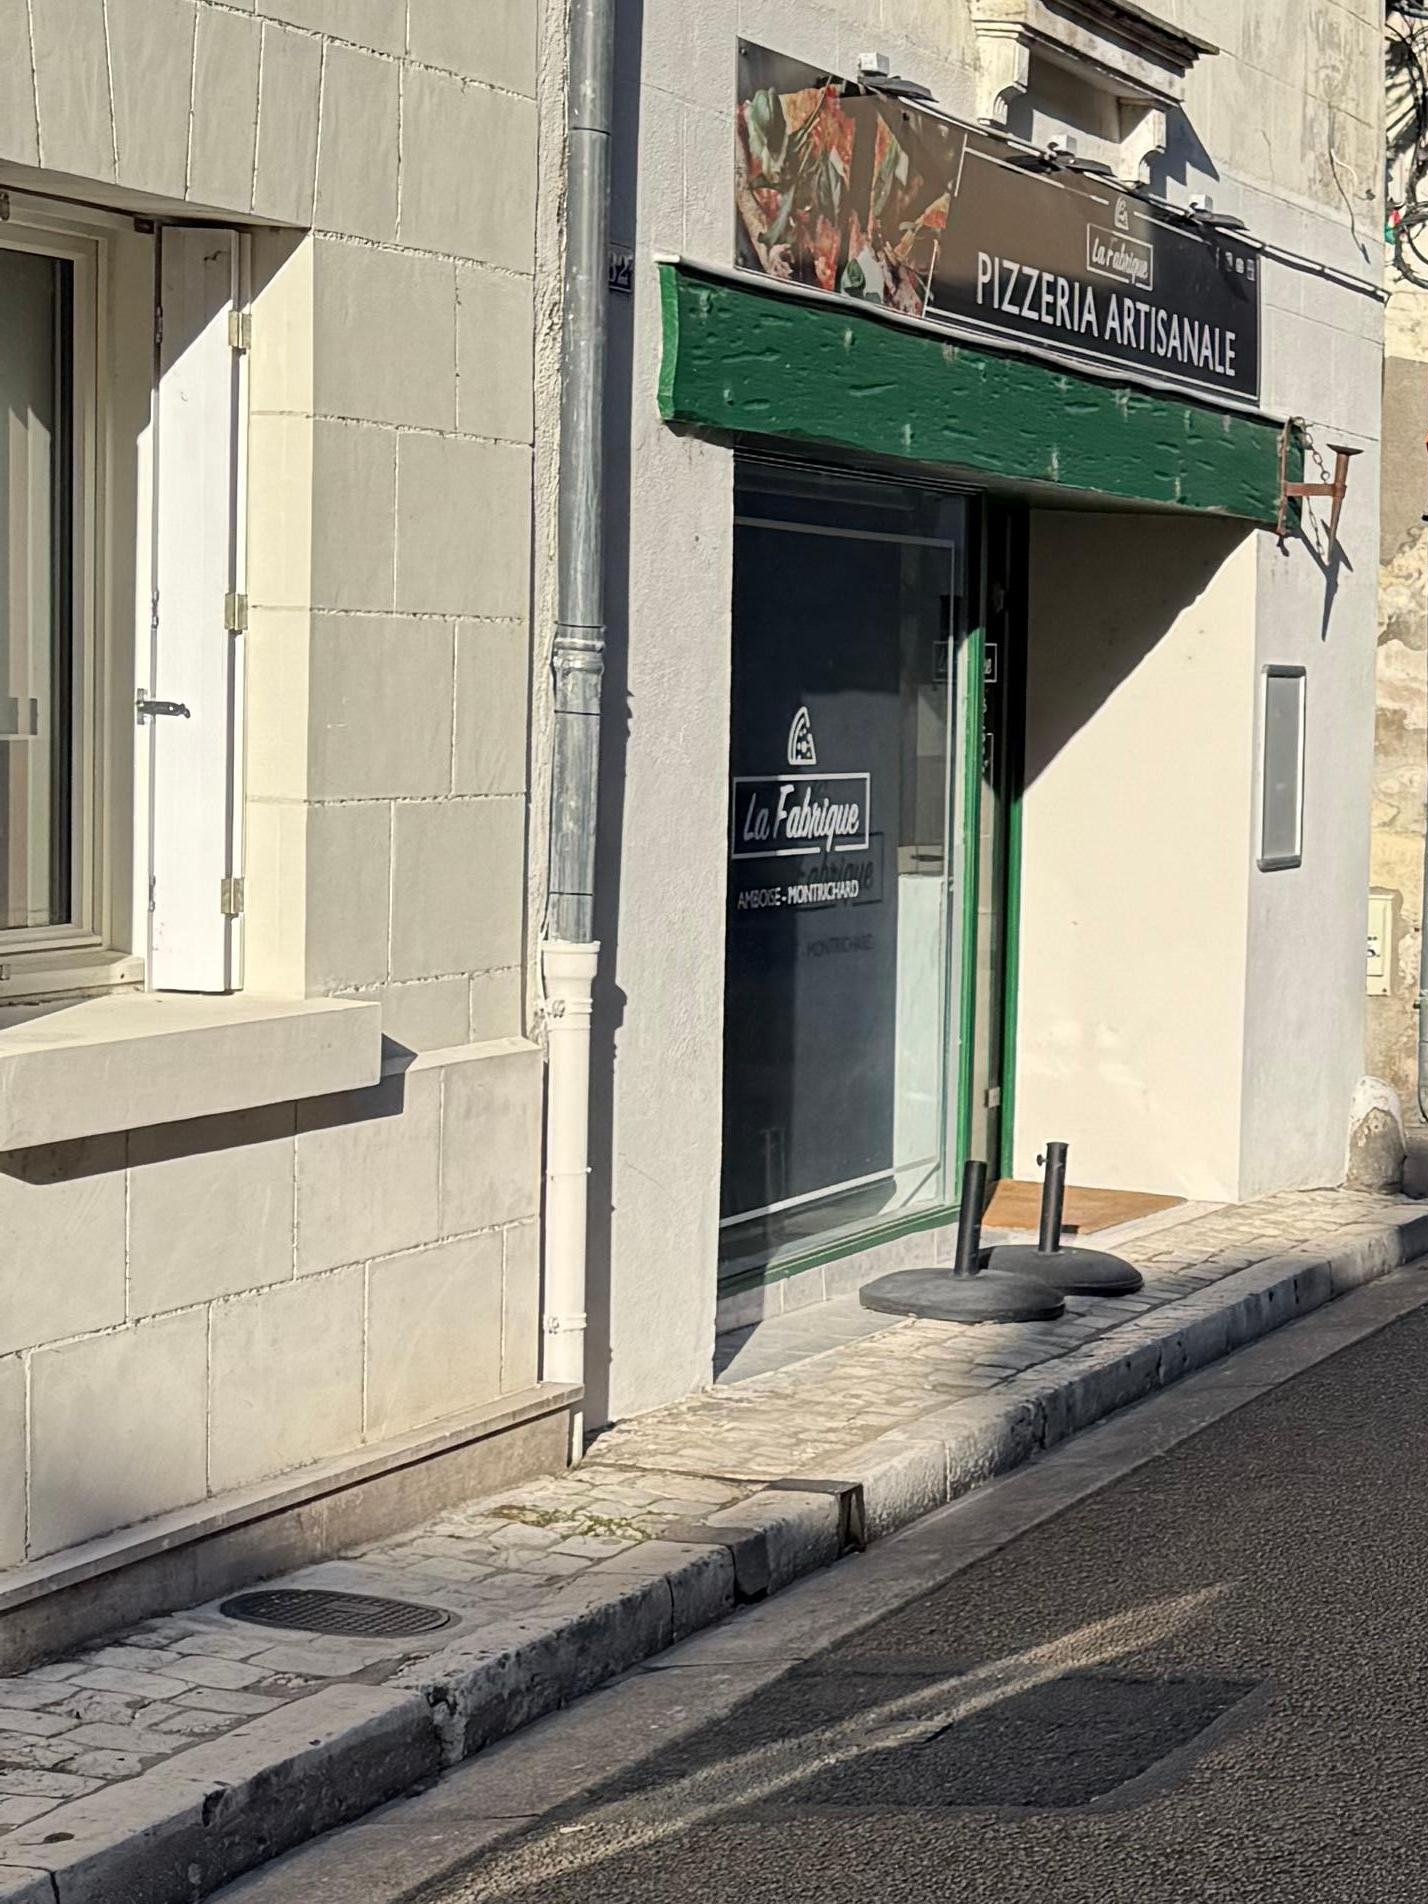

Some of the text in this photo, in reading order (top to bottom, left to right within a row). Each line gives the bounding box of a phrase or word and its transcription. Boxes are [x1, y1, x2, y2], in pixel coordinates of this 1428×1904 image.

[977, 251, 1236, 377] PIZZERIA ARTISANALE
[743, 784, 860, 852] La Fabrique
[737, 887, 781, 910] AMBOISE
[787, 880, 860, 905] MONTRICHARD
